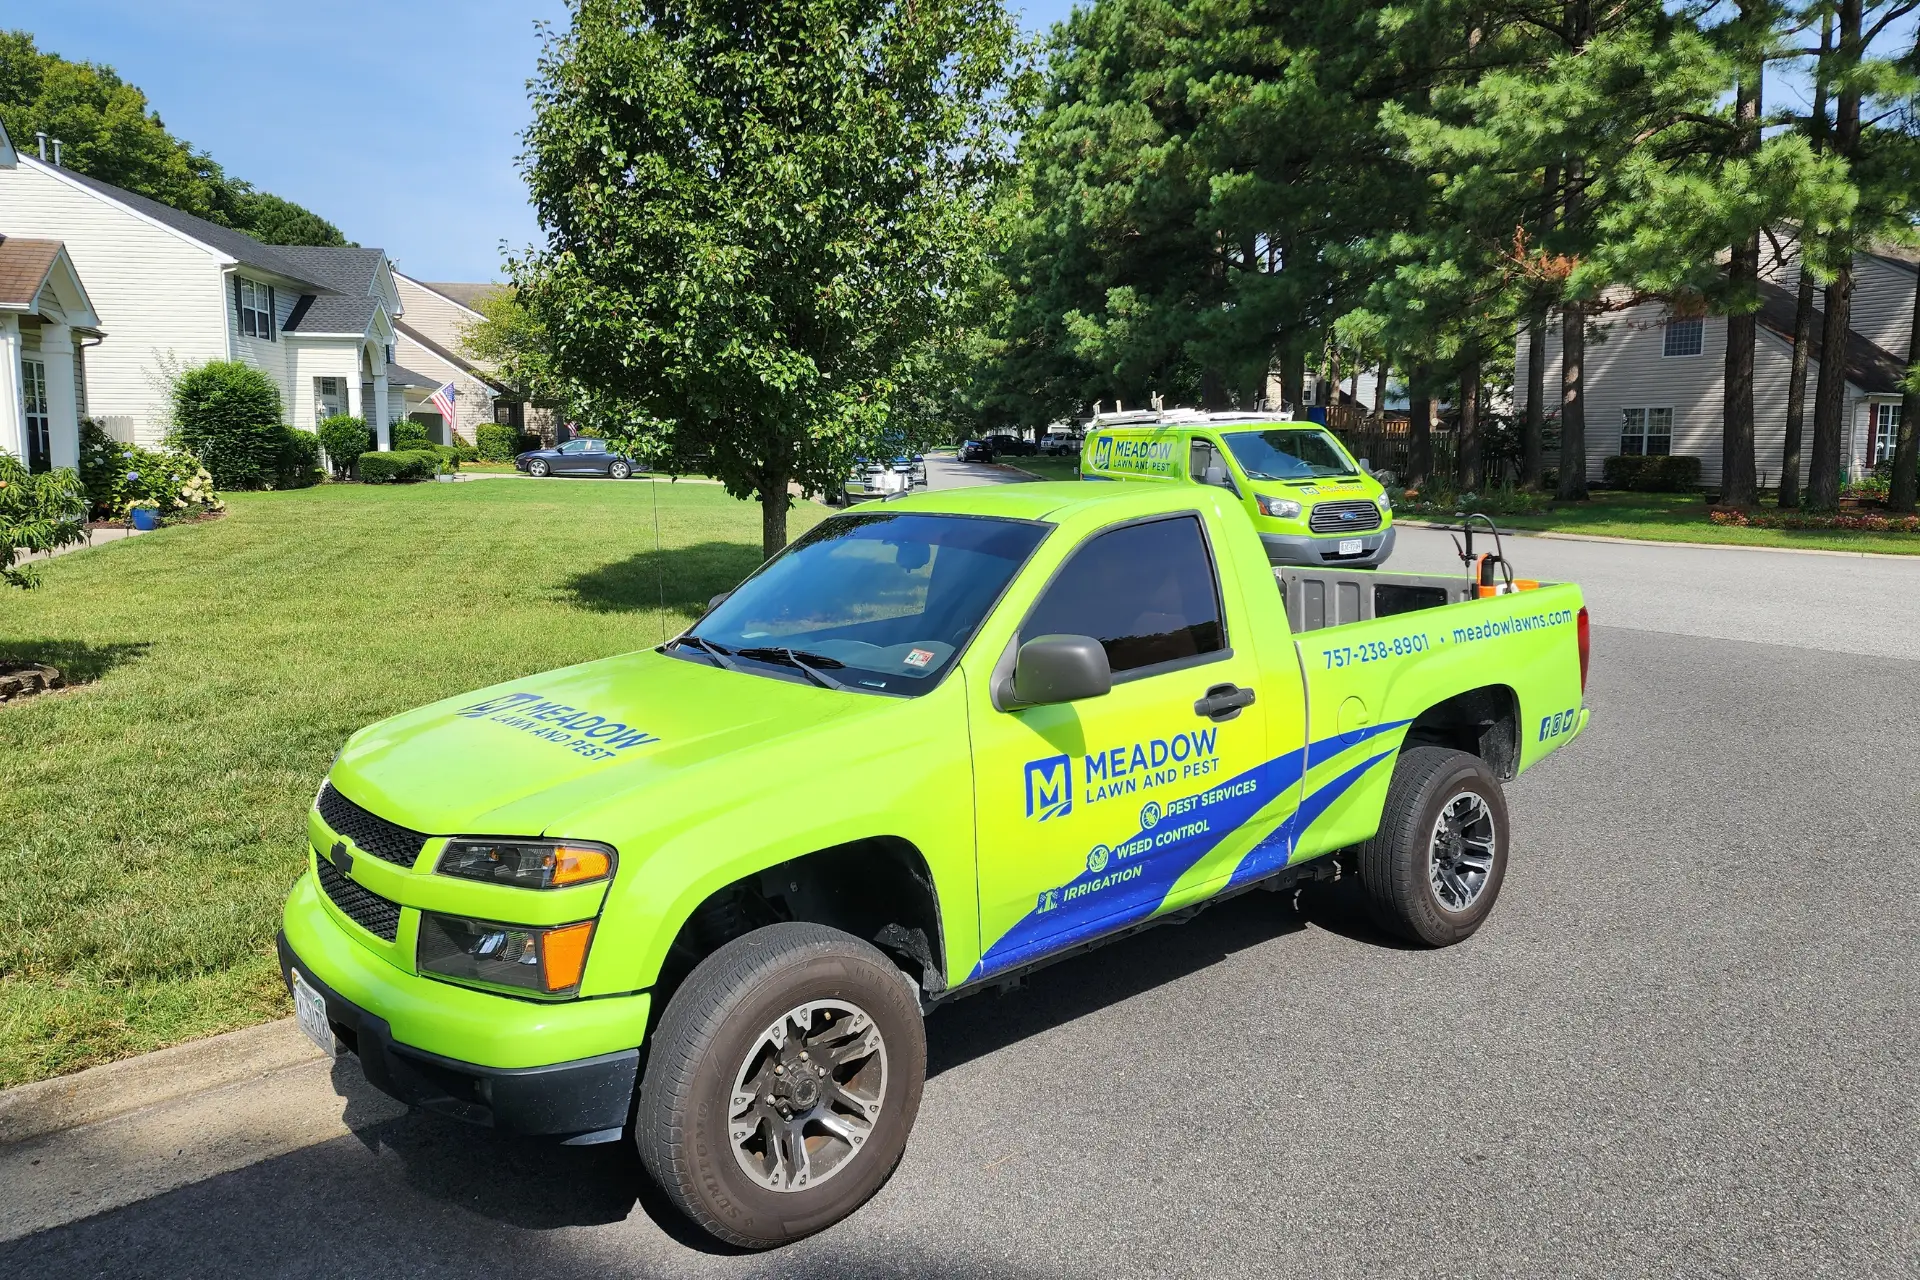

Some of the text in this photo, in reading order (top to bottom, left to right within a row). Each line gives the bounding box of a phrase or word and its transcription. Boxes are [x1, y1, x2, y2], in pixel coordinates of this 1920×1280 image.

[1113, 459, 1170, 472] LAWN AND PEST
[1115, 440, 1172, 460] MEADOW
[1323, 608, 1572, 670] 757-238-8901 meadowlawns.com
[489, 713, 617, 761] LAWN AND PEST
[516, 701, 662, 750] MEADOW
[1084, 727, 1218, 784] MEADOW
[1086, 757, 1220, 804] LAWN AND PEST
[1167, 780, 1258, 817] PEST SERVICES
[1116, 819, 1211, 860] WEED CONTROL
[1063, 865, 1143, 902] IRRIGATION
